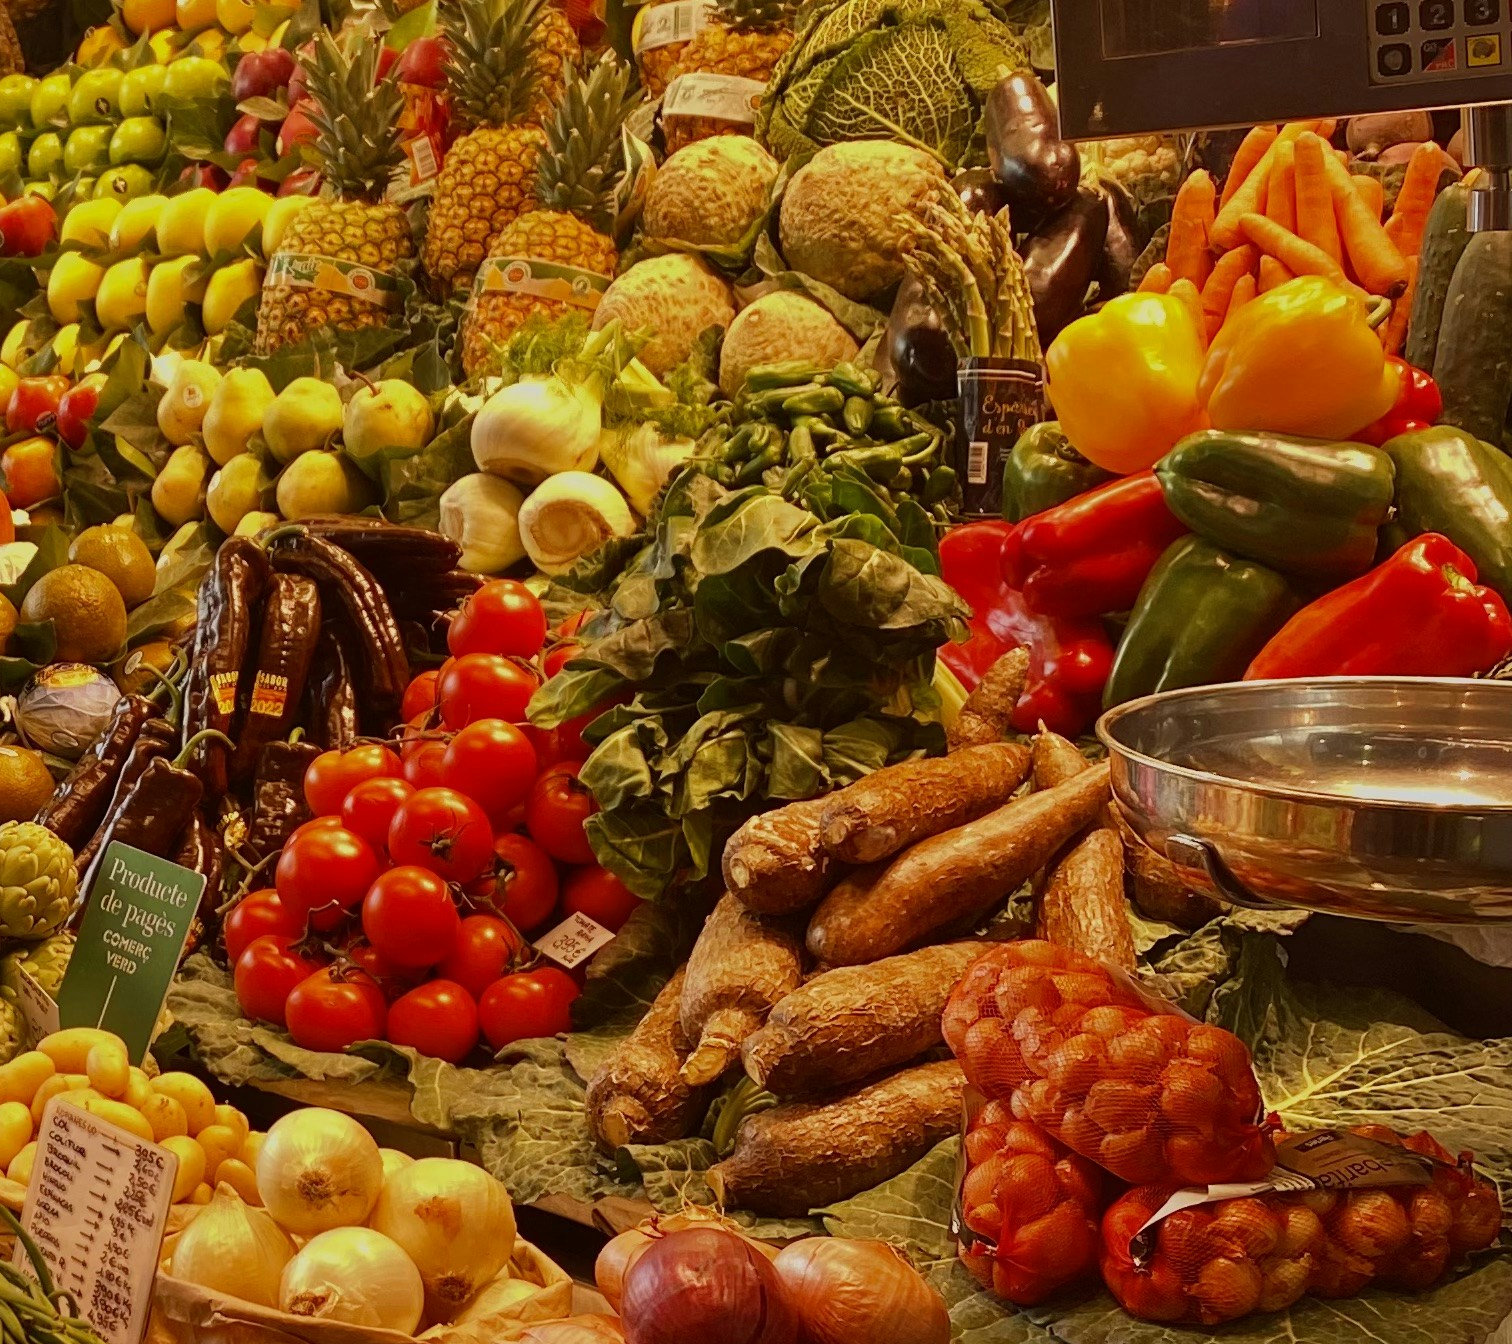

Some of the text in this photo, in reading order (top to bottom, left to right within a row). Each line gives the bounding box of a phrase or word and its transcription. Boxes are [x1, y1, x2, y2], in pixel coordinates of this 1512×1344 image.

[109, 858, 188, 908] Producte
[100, 889, 176, 938] de pagès
[103, 929, 152, 964] COMERÇ
[106, 951, 137, 974] VERD
